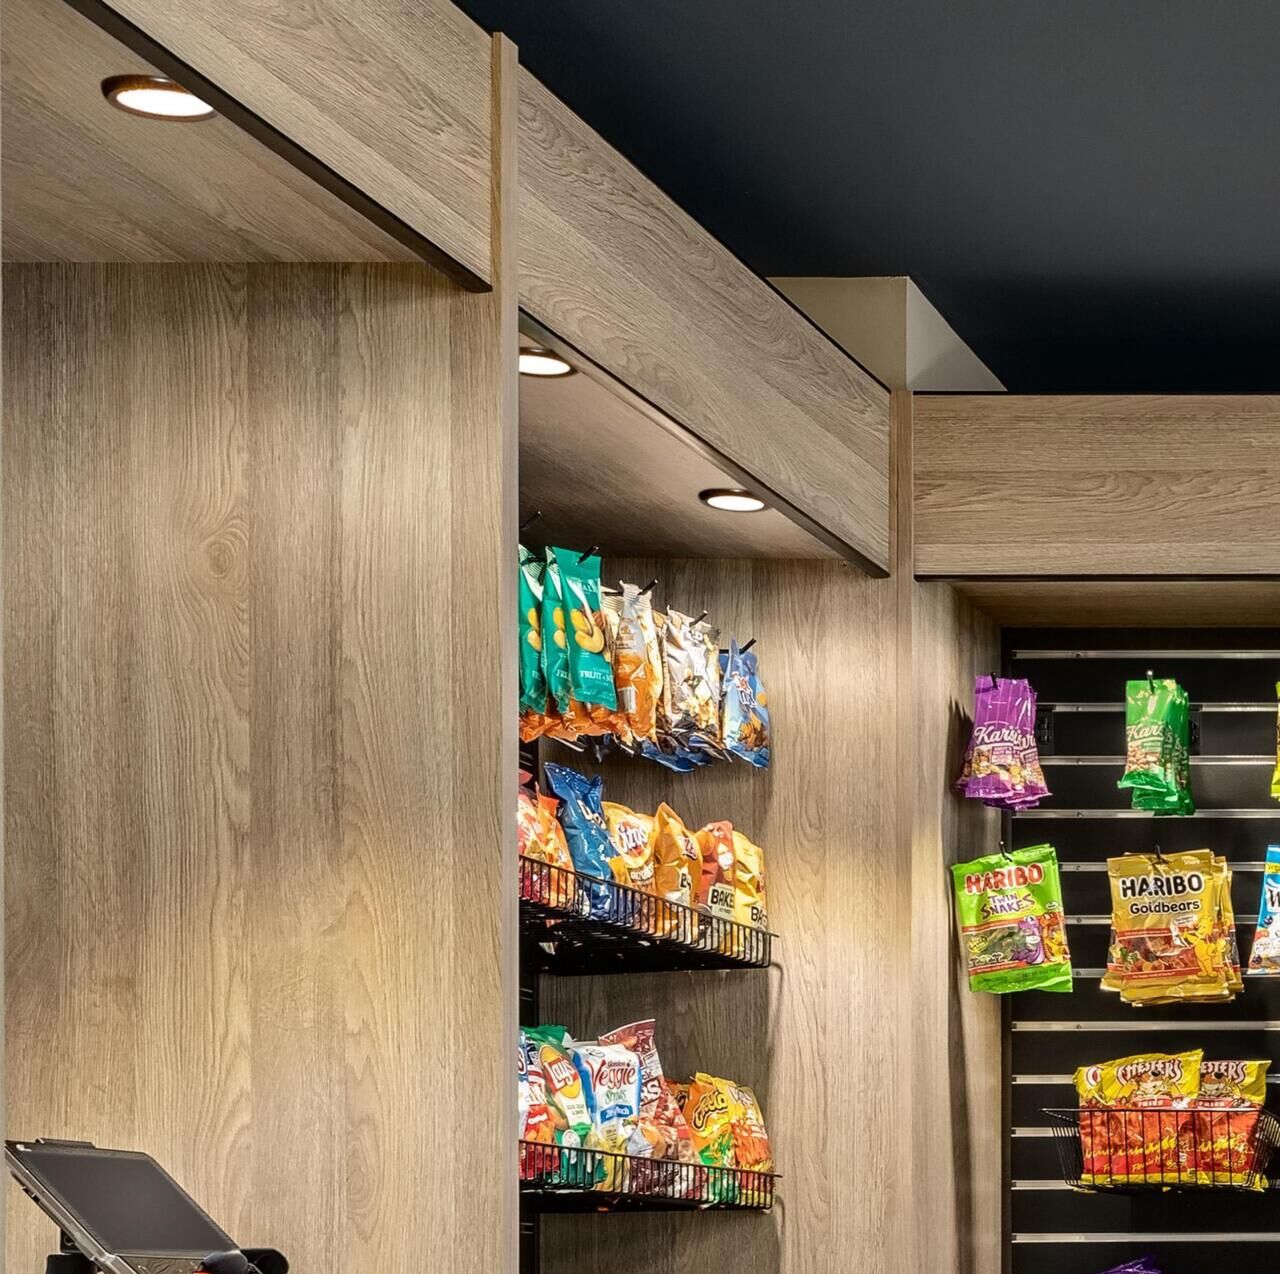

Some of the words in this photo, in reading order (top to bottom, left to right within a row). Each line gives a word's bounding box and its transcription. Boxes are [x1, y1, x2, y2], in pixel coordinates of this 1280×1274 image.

[965, 863, 1044, 895] HARIBO
[1120, 873, 1204, 898] HARIBO
[981, 894, 1036, 919] SNAKES
[988, 893, 1018, 904] TWIN
[1129, 901, 1200, 914] Goldbears
[588, 1059, 637, 1091] Veggie
